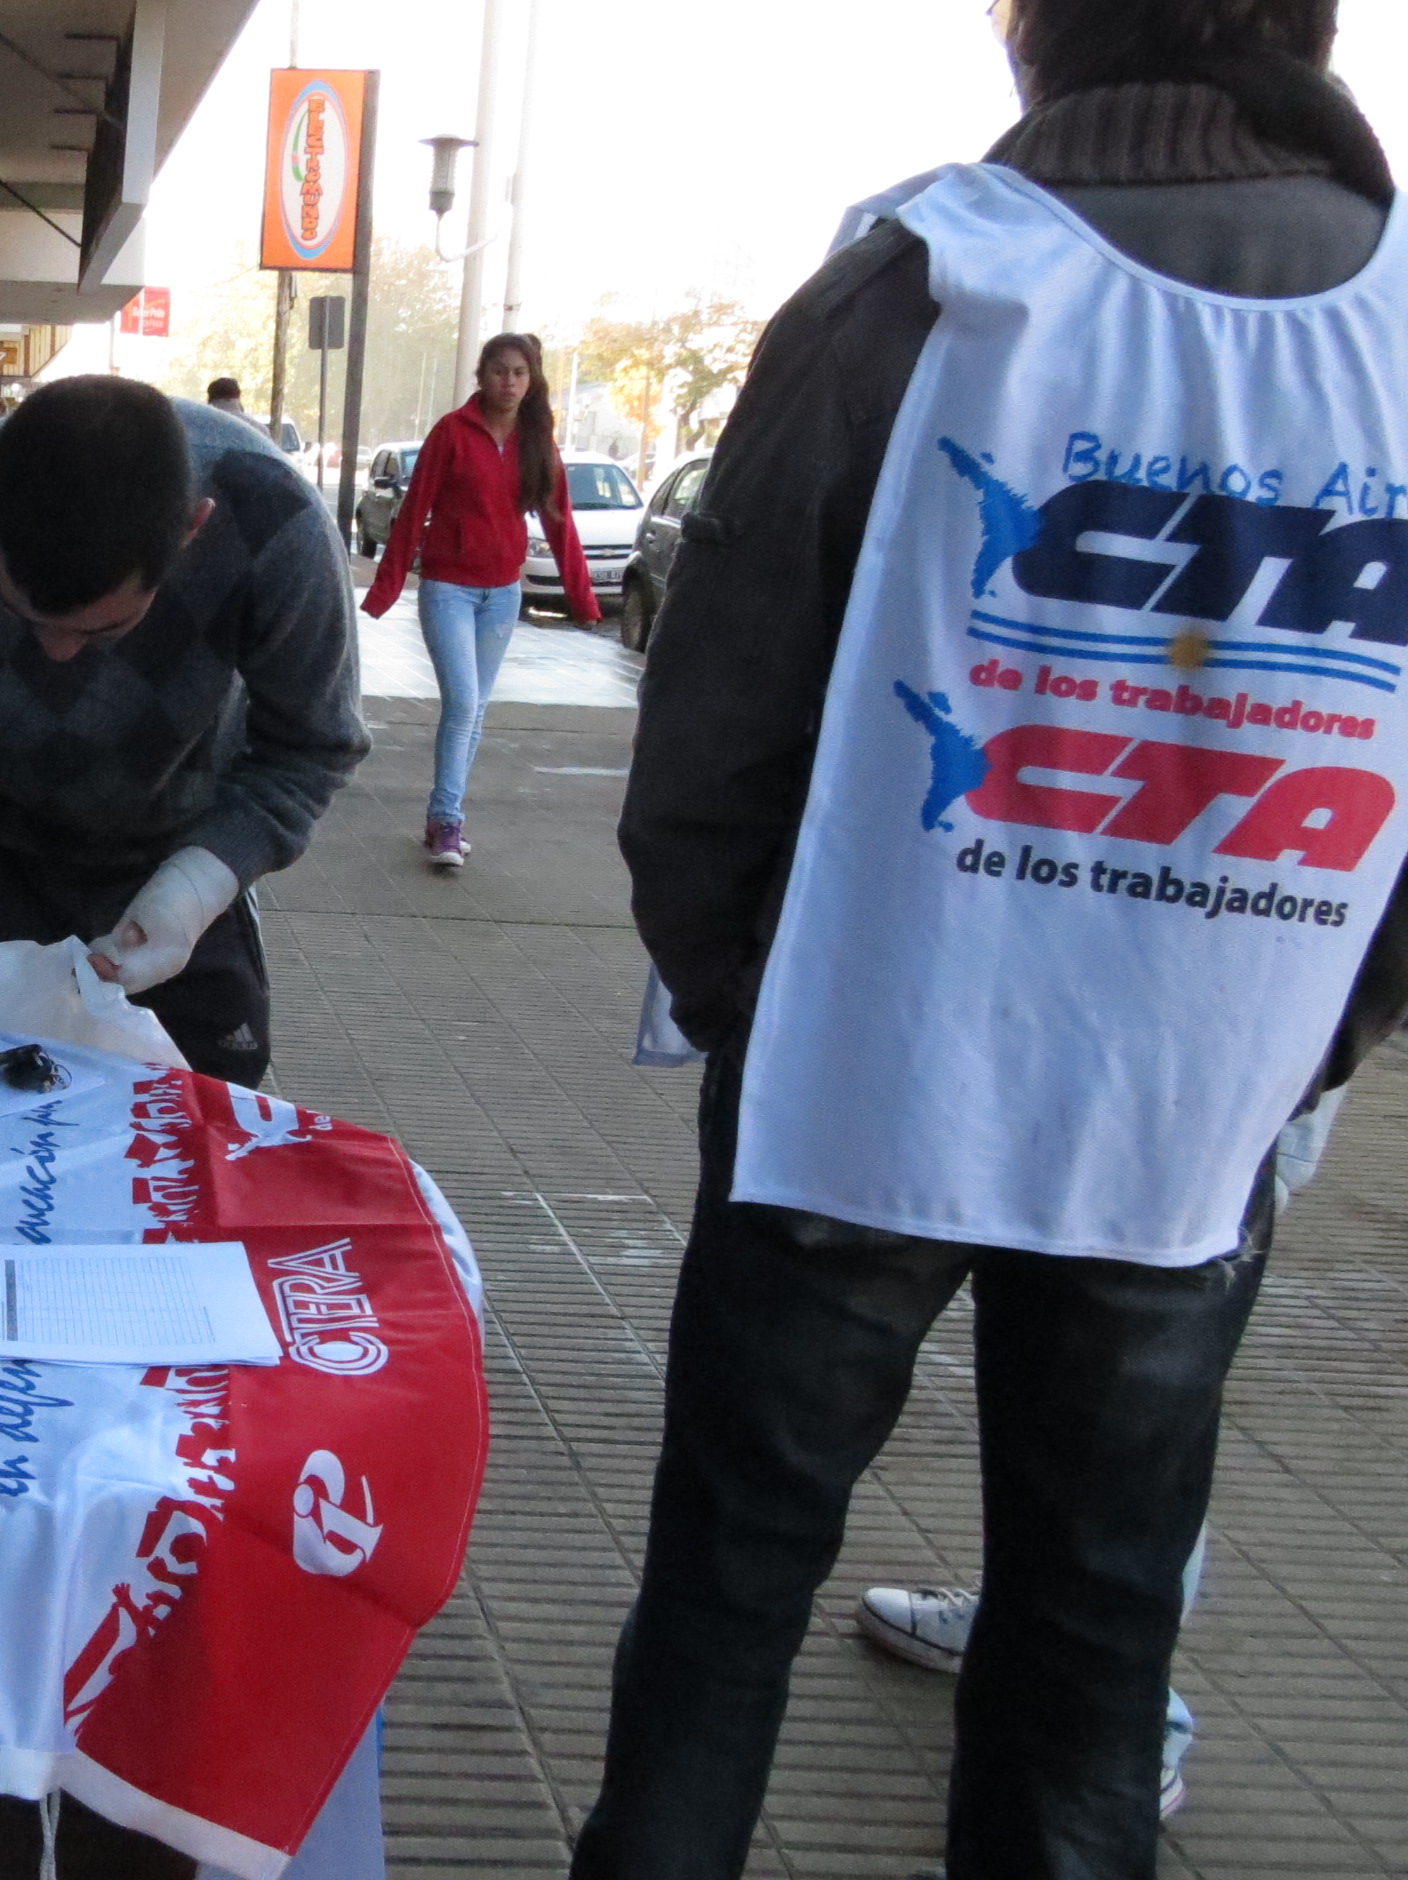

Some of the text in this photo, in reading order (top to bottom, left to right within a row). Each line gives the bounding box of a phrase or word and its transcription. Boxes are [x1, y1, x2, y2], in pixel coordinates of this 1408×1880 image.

[1063, 432, 1408, 519] Buenos Air
[1012, 479, 1408, 647] CTA
[969, 659, 1376, 741] de los trabajadores
[964, 725, 1397, 872] CTA
[956, 839, 1348, 928] de los trabajadores
[267, 1237, 389, 1376] CTERA
